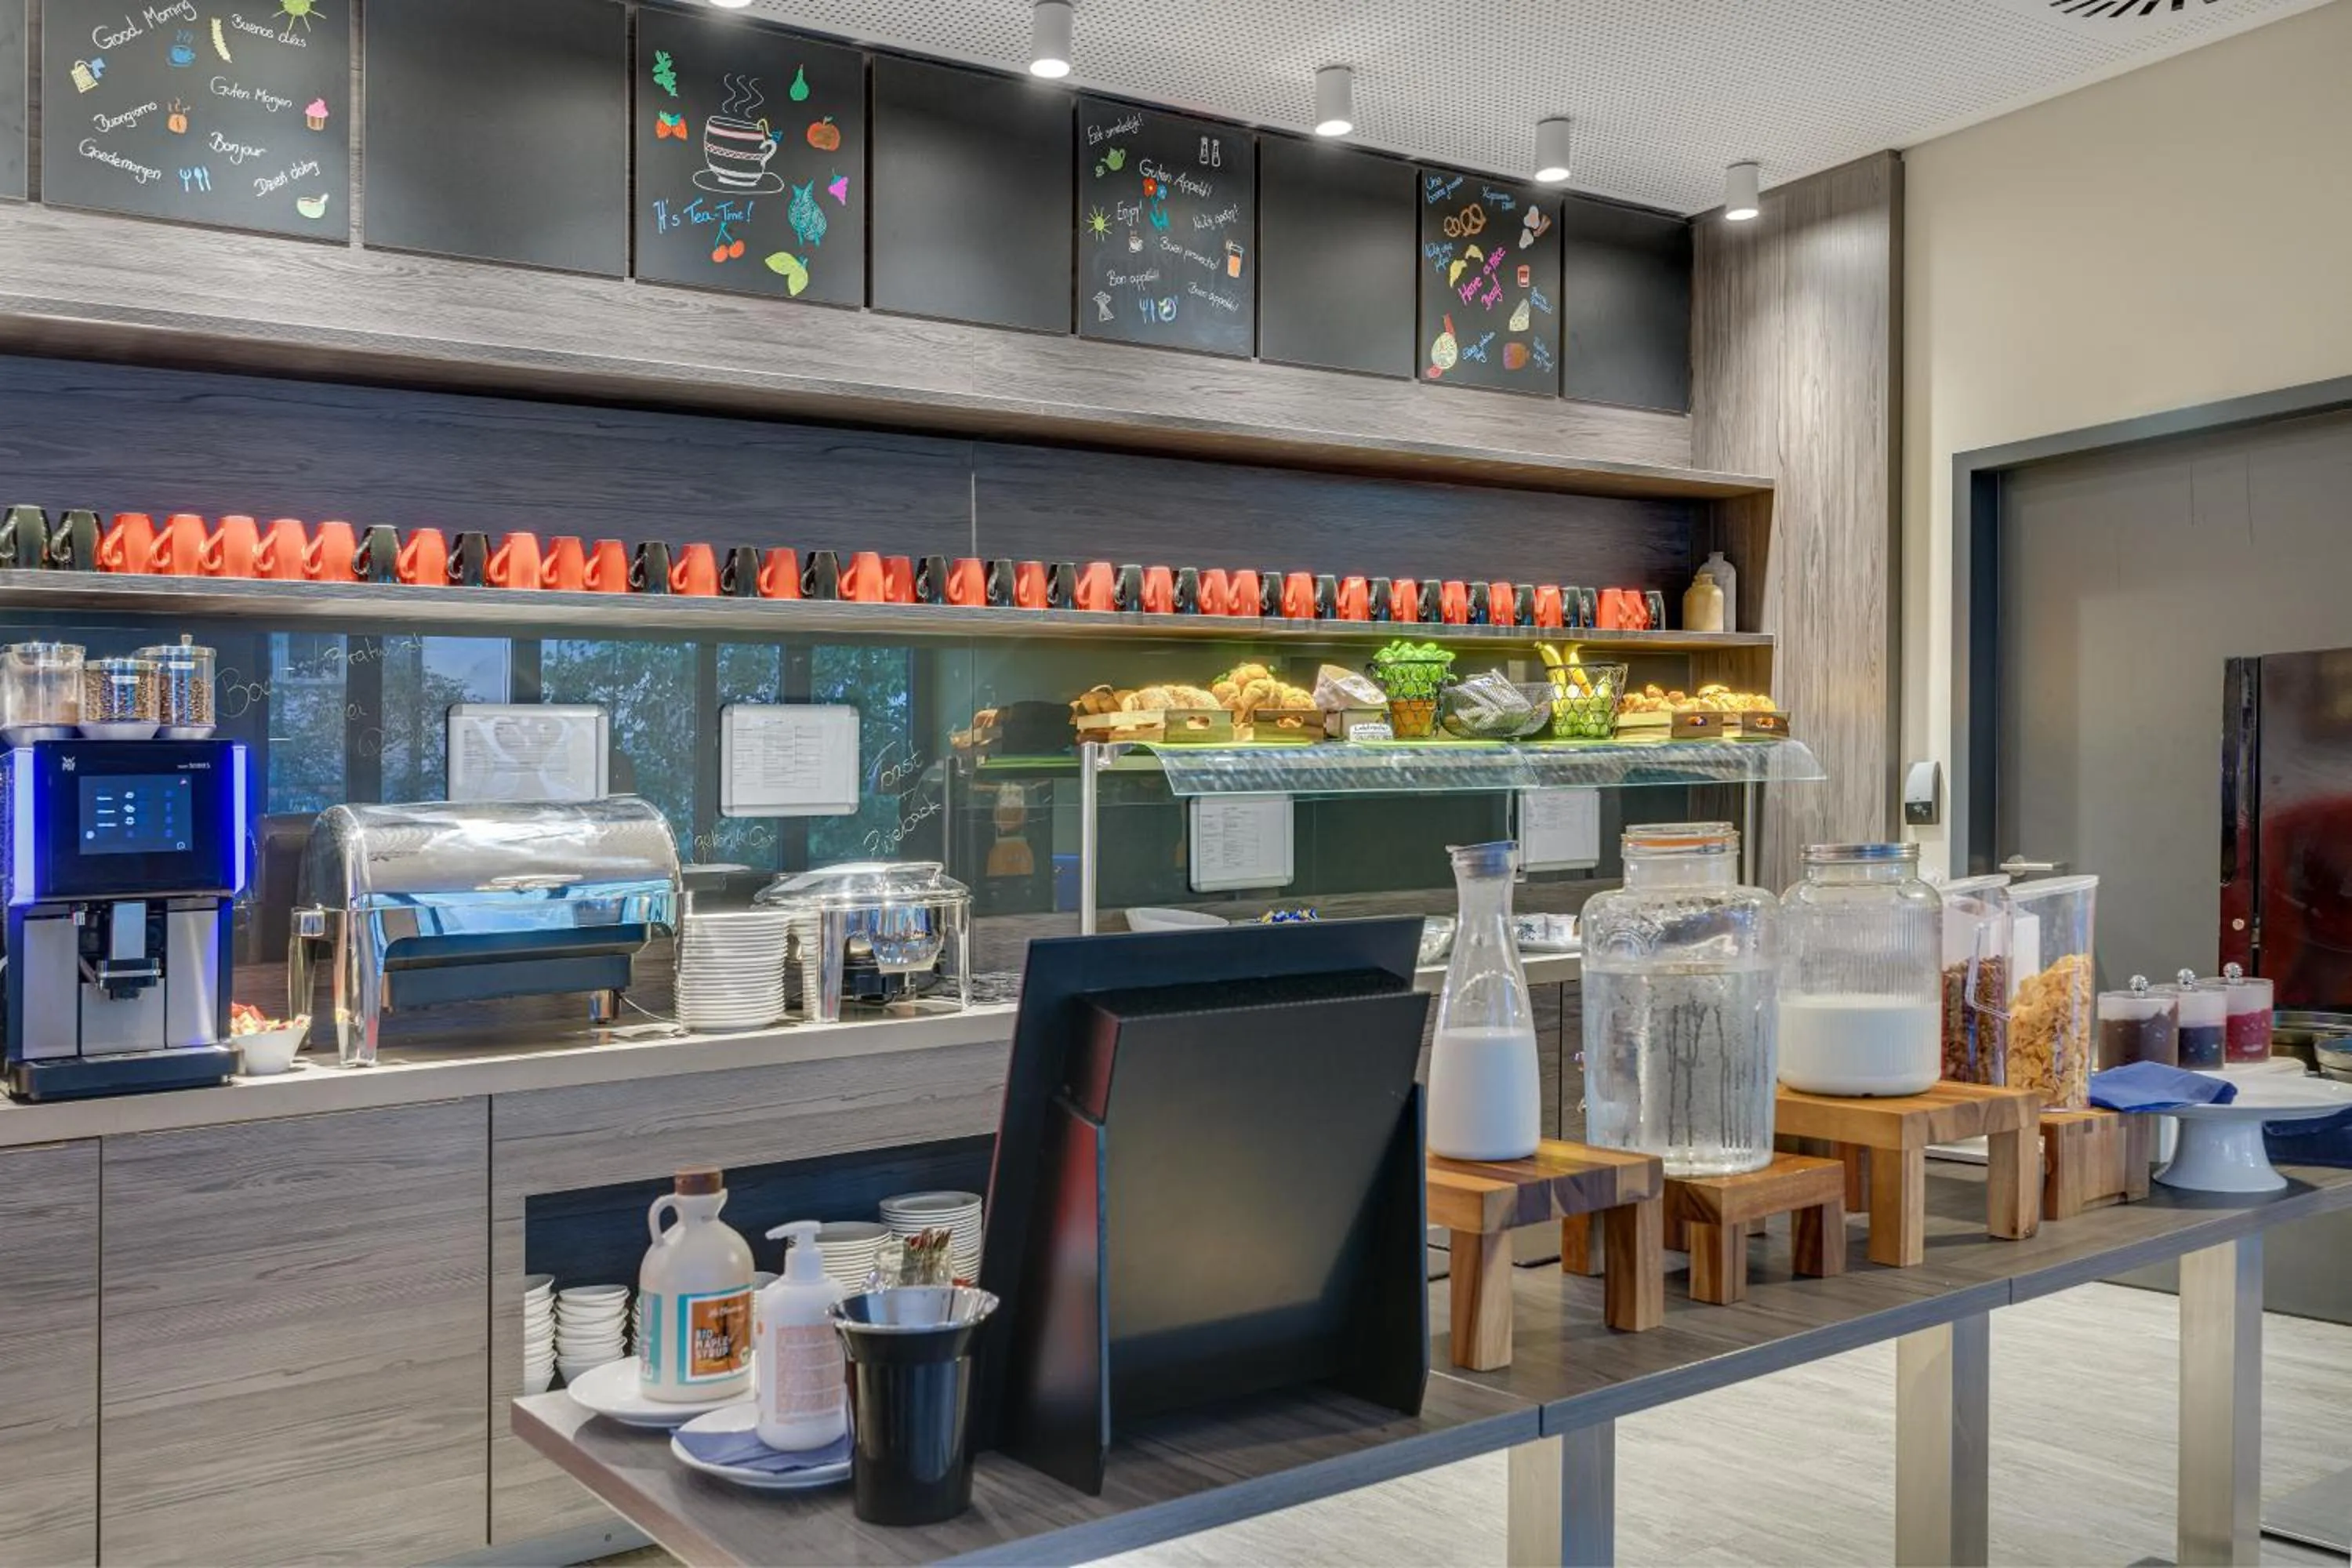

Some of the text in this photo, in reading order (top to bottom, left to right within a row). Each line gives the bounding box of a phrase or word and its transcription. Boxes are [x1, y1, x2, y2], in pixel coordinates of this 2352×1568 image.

[92, 0, 197, 49] Good Morning
[231, 13, 274, 38] Buenos
[209, 76, 292, 112] Guten Morgen
[93, 102, 158, 132] Buongiorno
[79, 138, 162, 183] Goedemorgen
[209, 131, 267, 165] Bonjour
[1139, 158, 1172, 182] Guten
[652, 198, 681, 234] It's
